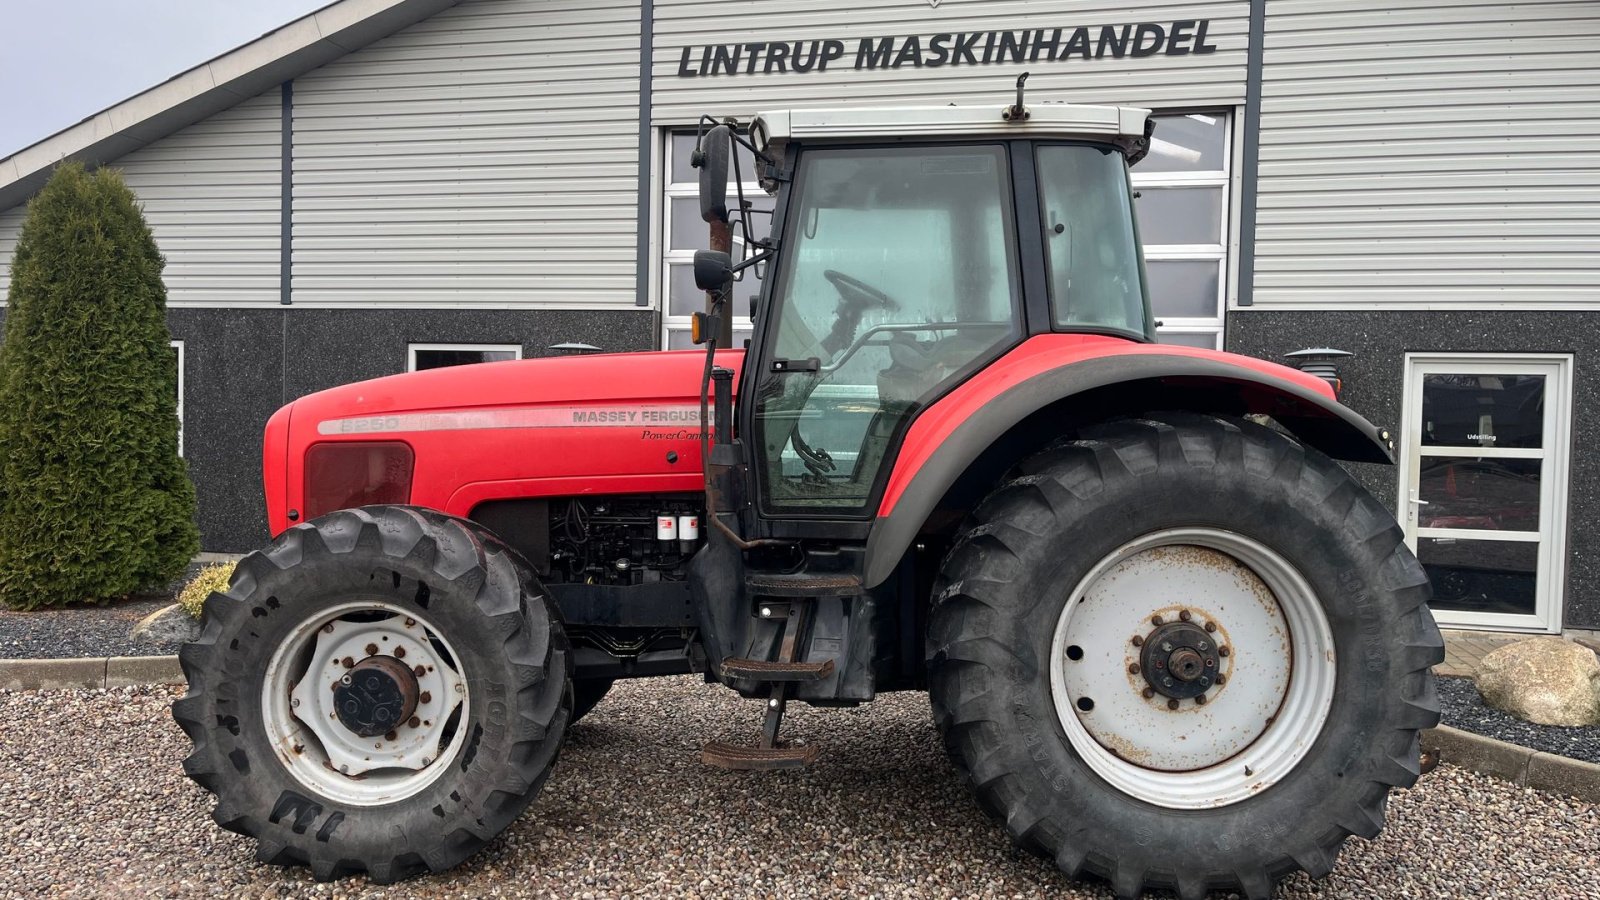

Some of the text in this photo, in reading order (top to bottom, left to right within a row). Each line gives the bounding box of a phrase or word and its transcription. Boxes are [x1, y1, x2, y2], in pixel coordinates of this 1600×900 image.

[678, 20, 1217, 77] LINTRUP MASKINHANDEL
[573, 411, 715, 423] MASSEY FERGUSN
